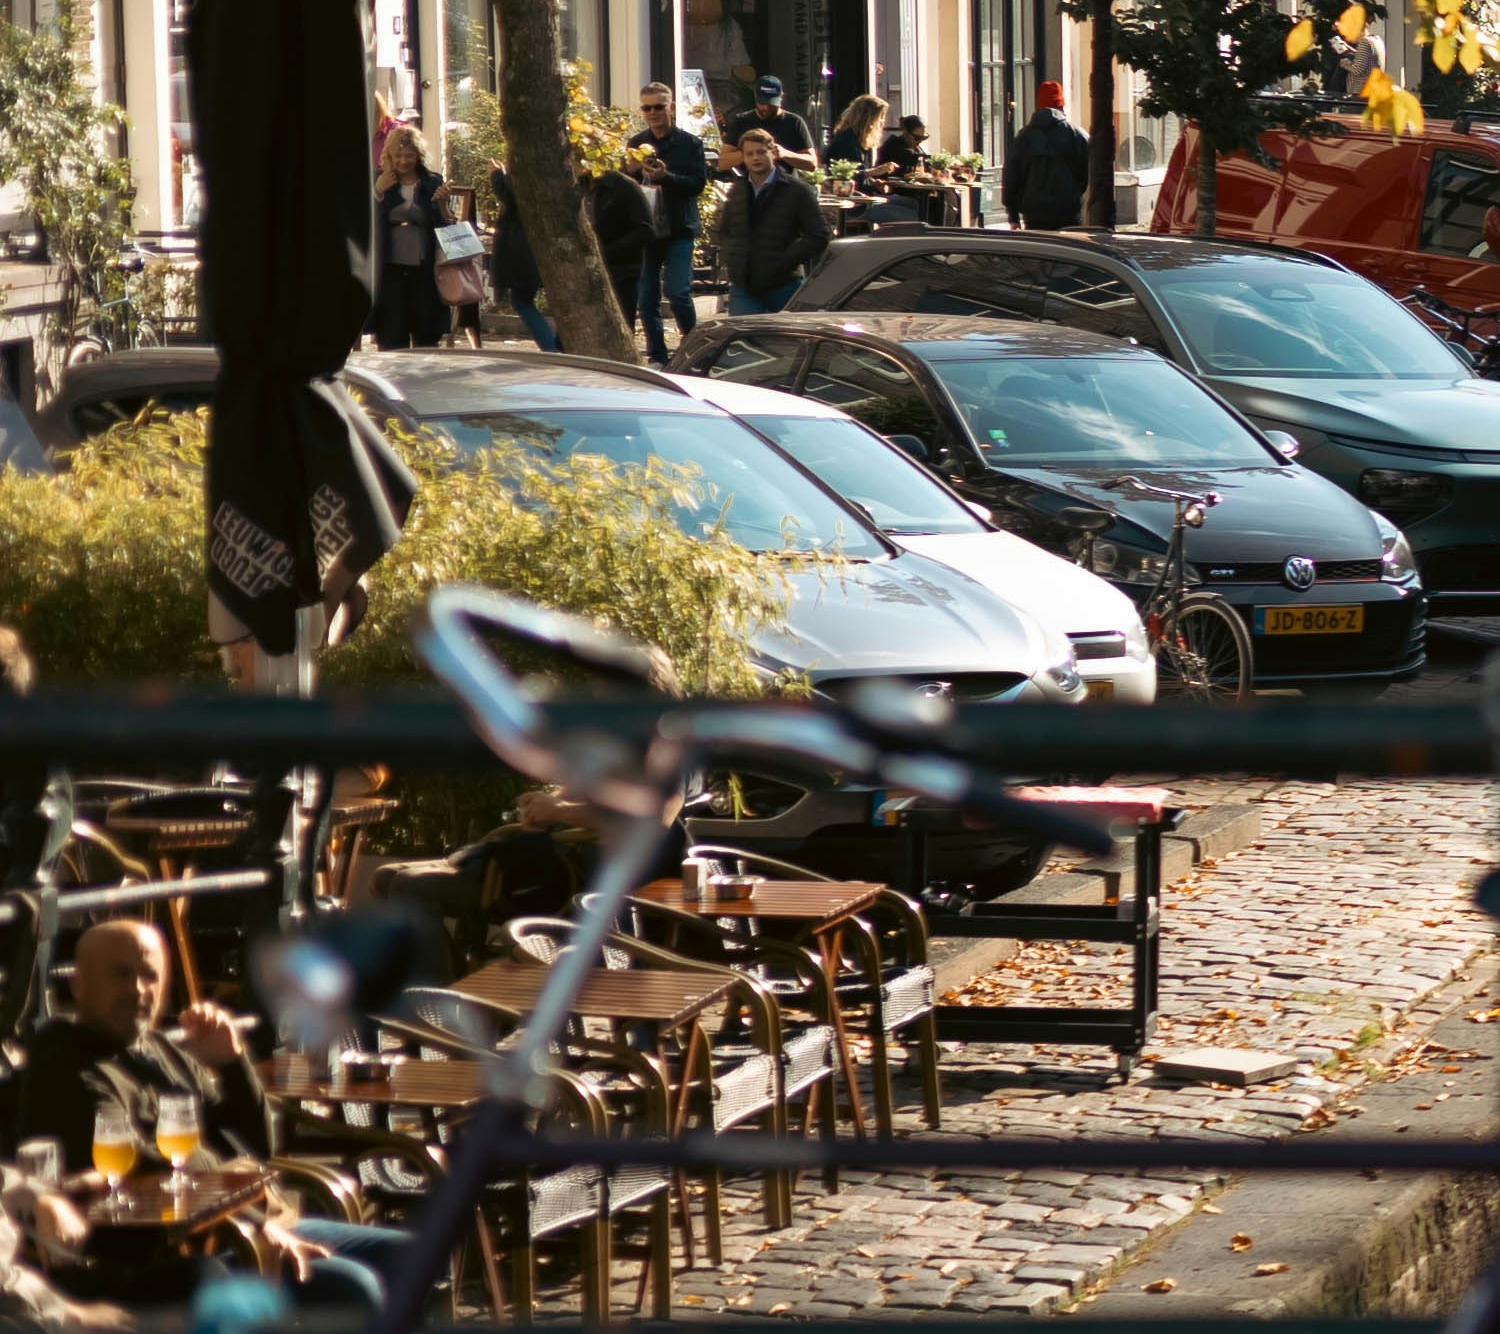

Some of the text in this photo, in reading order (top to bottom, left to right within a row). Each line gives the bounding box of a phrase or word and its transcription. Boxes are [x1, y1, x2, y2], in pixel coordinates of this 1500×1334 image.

[794, 2, 807, 35] AND
[795, 42, 808, 102] SALADS
[1270, 609, 1358, 632] JD-806-Z
